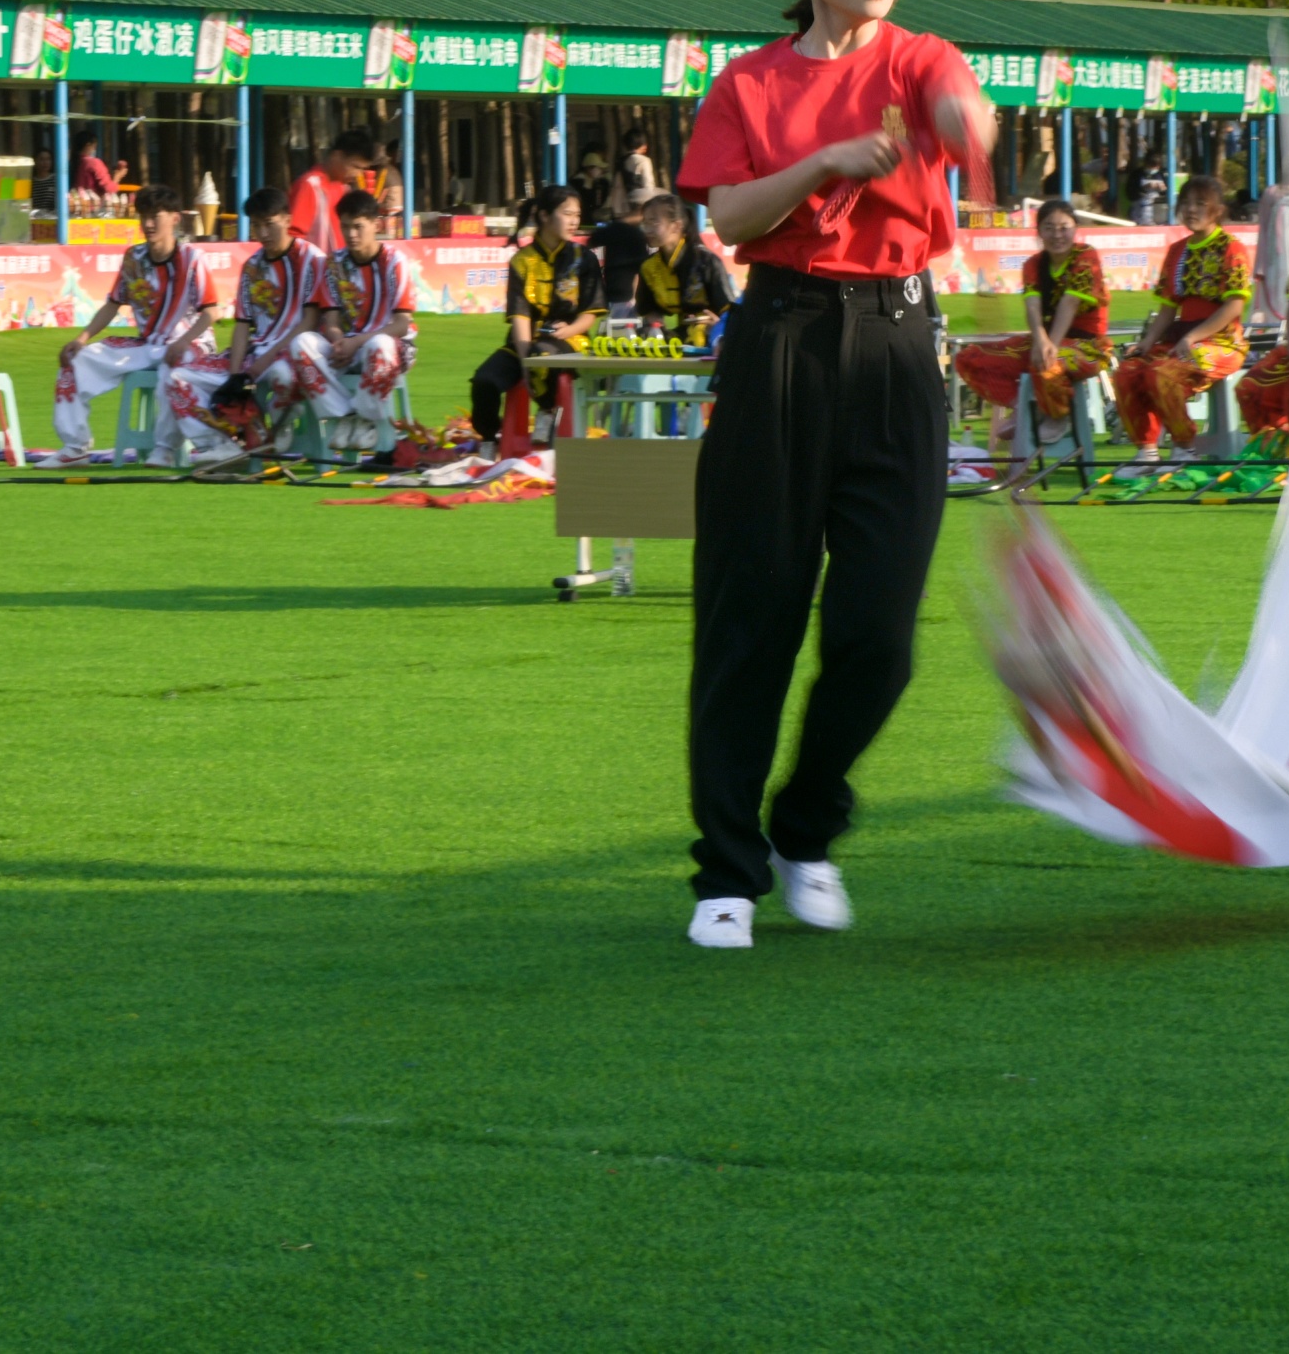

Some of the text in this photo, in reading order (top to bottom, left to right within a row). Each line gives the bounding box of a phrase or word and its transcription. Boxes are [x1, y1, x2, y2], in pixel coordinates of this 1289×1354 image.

[73, 18, 194, 57] 鸡蛋仔冰激凌
[252, 28, 363, 58] 旋风薯塔脆皮玉米
[1074, 59, 1144, 90] 大连火爆鱿鱼
